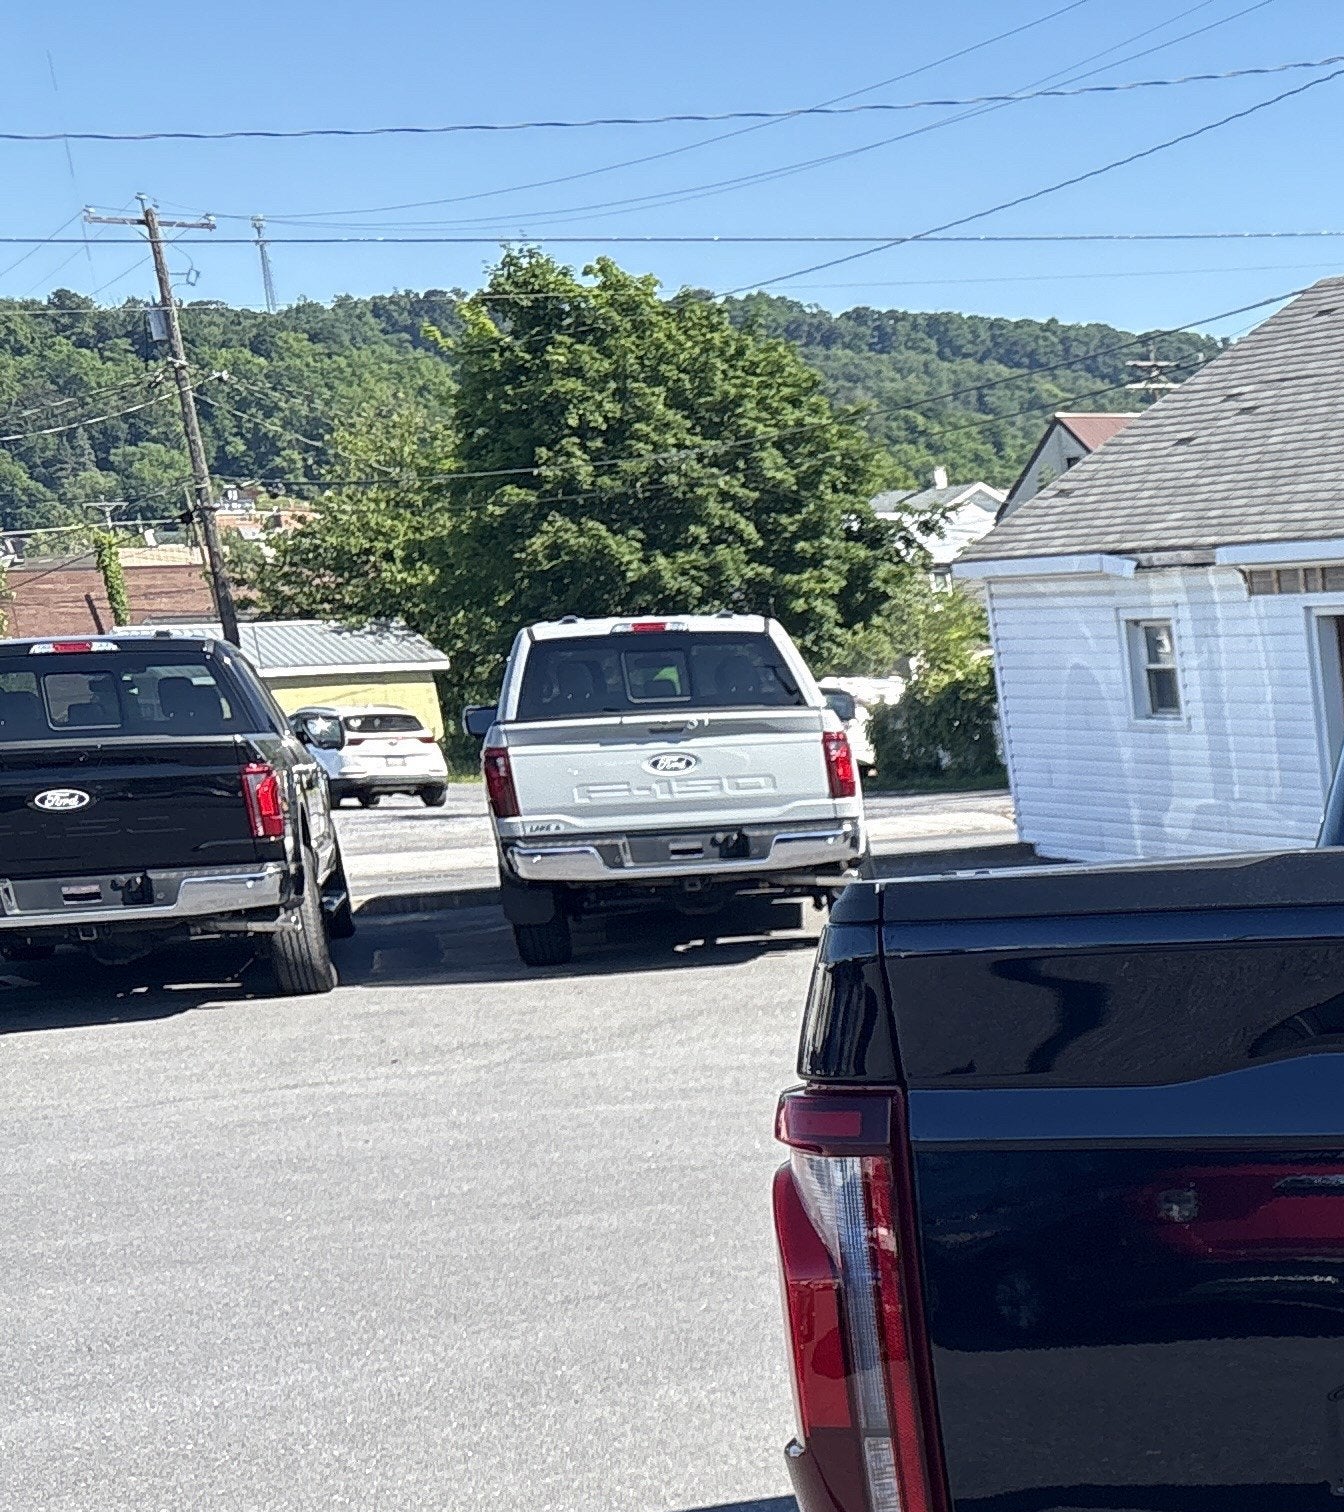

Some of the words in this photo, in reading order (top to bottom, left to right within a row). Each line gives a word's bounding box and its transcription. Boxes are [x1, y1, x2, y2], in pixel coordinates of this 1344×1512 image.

[654, 754, 693, 771] Ford
[574, 774, 777, 803] F-150
[44, 791, 79, 808] Ford
